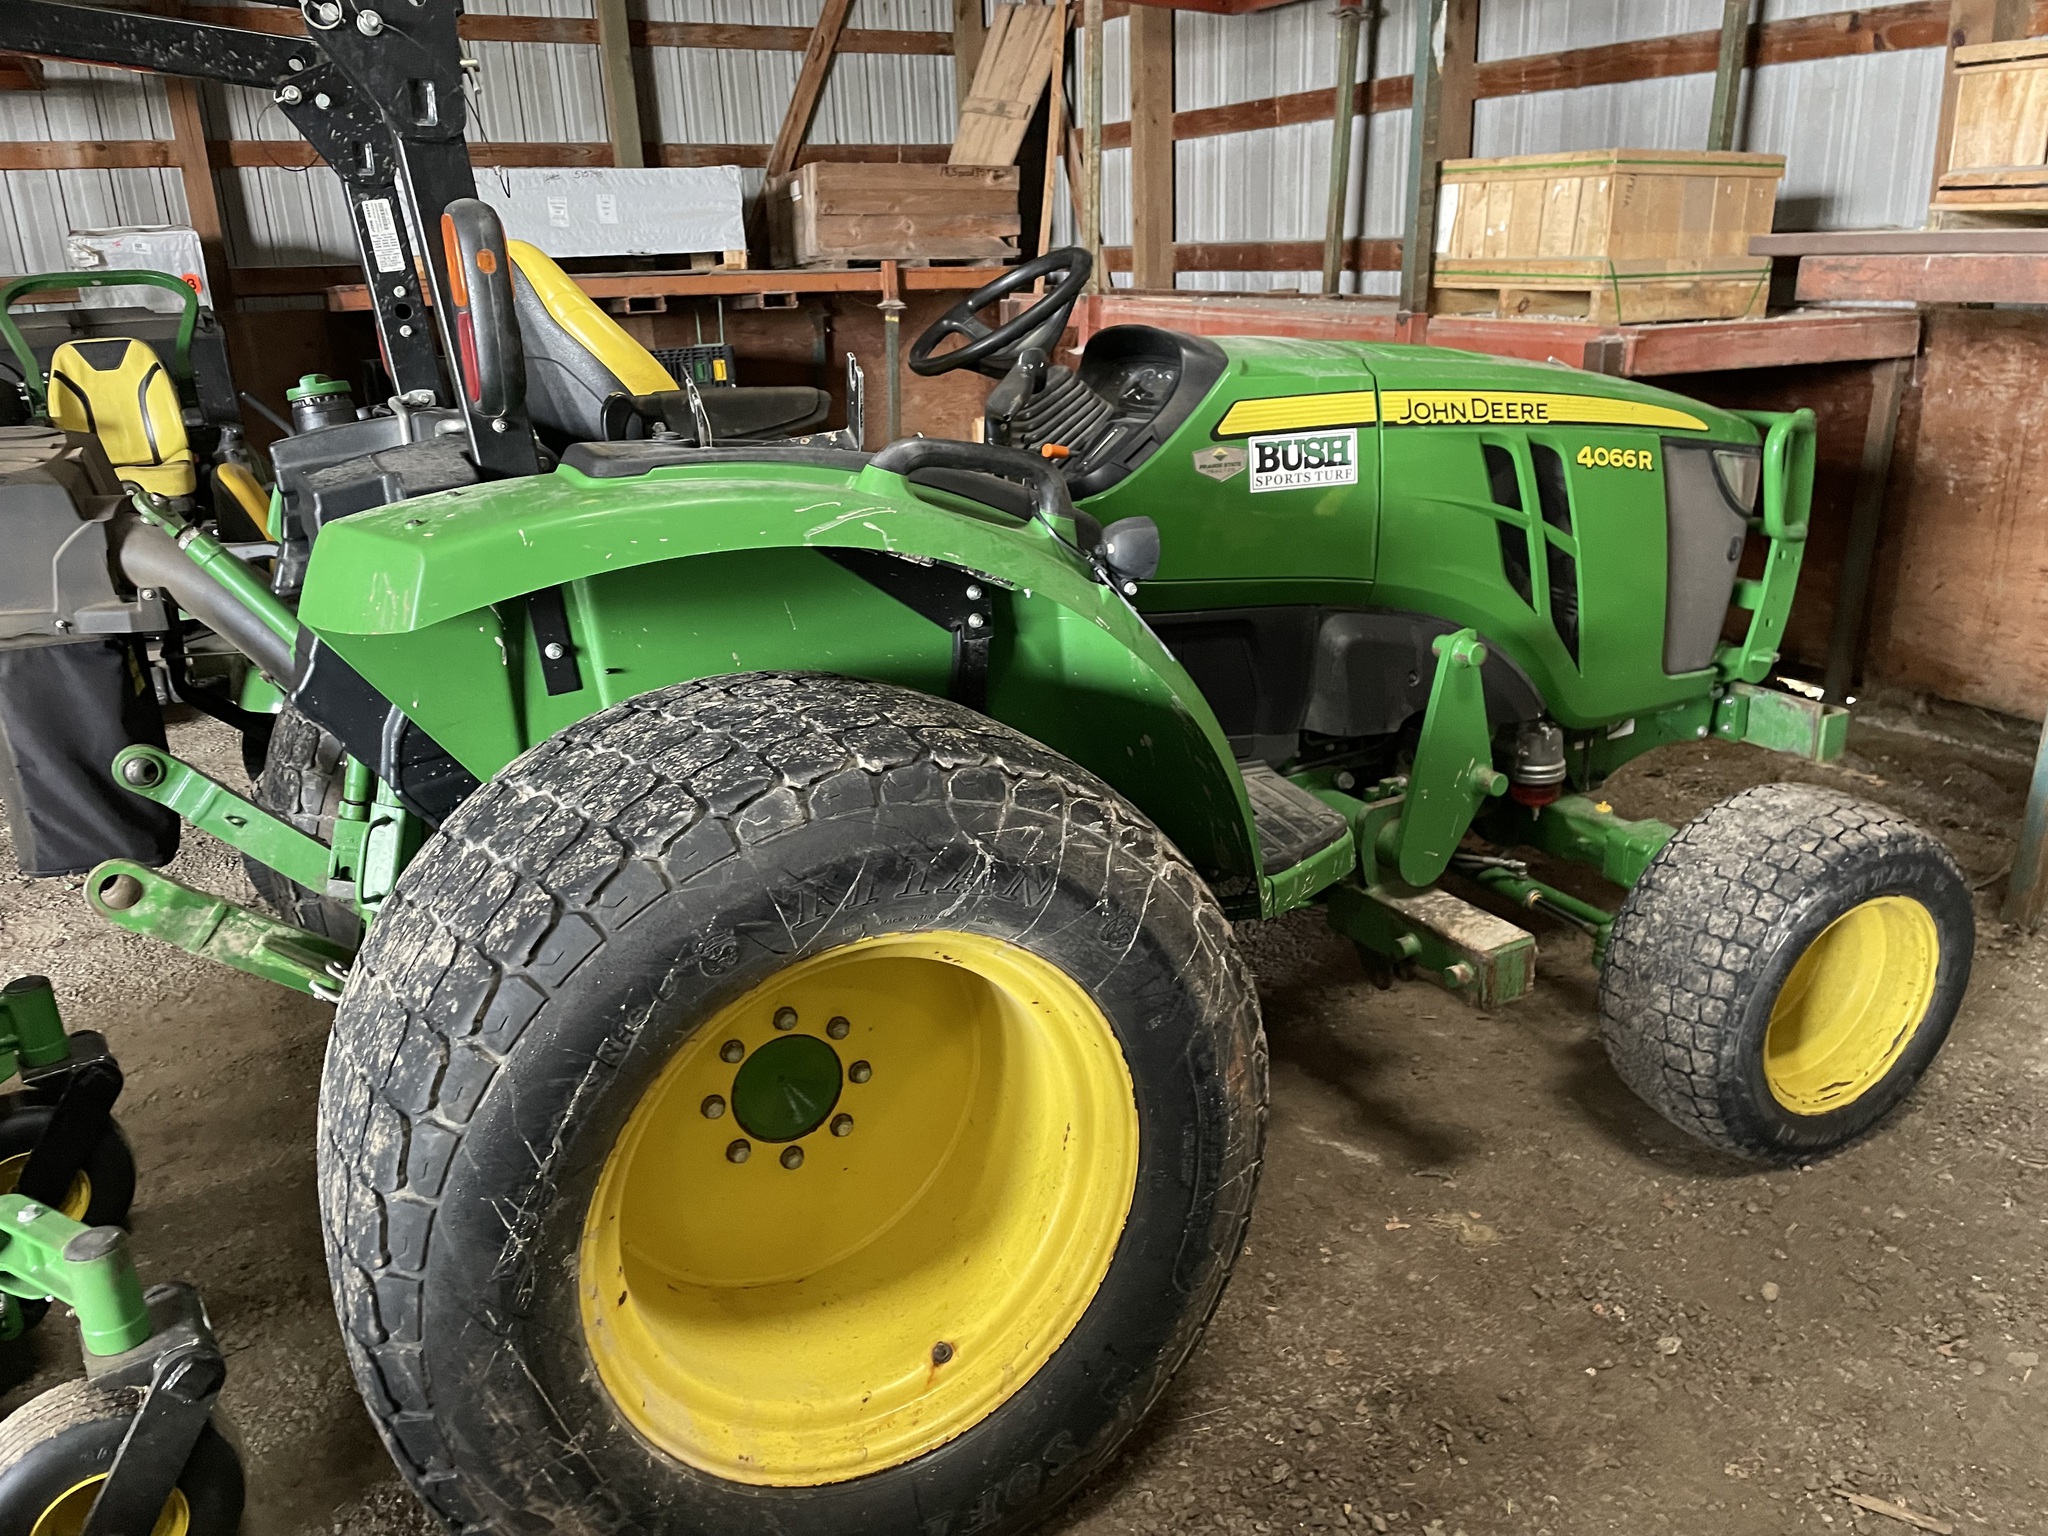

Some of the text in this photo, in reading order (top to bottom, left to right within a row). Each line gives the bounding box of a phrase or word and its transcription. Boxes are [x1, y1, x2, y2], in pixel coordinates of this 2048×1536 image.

[1400, 398, 1549, 420] JOHN DEERE
[1255, 435, 1352, 473] BUSH
[1576, 445, 1654, 471] 4066R
[1255, 469, 1352, 487] SPORTS TURF
